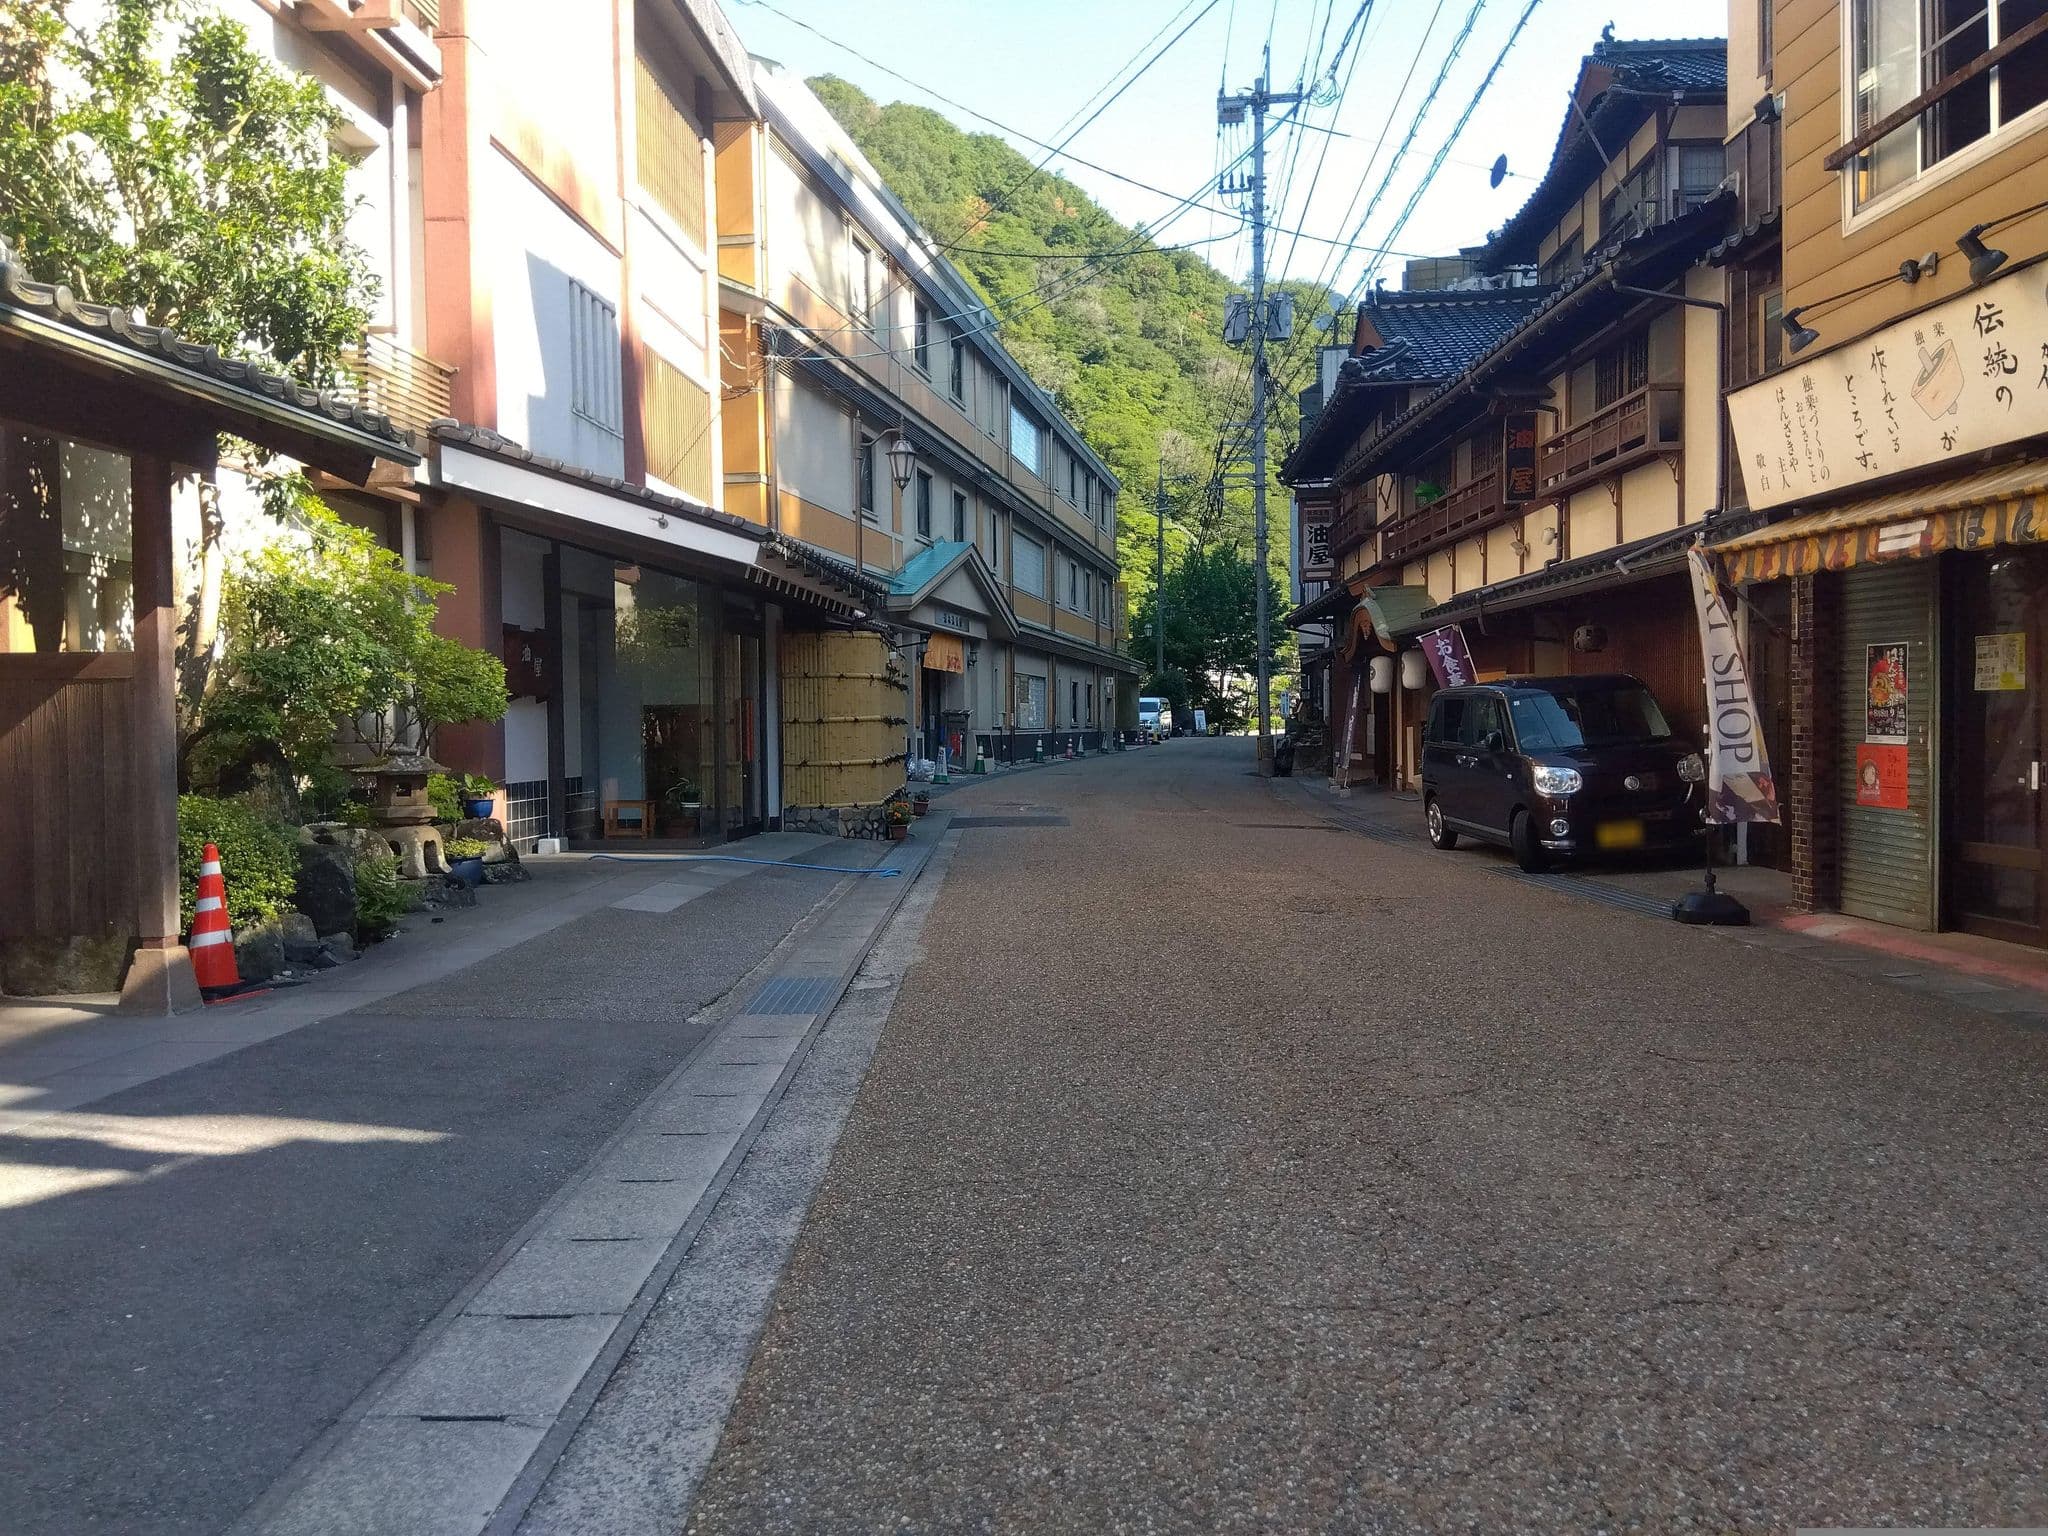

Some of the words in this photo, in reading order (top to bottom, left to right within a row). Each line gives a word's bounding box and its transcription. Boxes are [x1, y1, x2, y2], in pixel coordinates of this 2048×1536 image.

[1913, 321, 1945, 346] 独楽
[1973, 302, 2018, 411] 伝統の
[1775, 386, 1799, 473] はんざきや
[1801, 375, 1831, 481] 独楽づくりの
[1844, 375, 1878, 471] ところです。
[1870, 345, 1901, 453] 作られている
[1941, 426, 1960, 451] が
[1776, 456, 1791, 490] 主人
[1795, 401, 1818, 484] おじさんこと
[1307, 523, 1330, 566] 油屋
[1435, 638, 1466, 687] お食事
[1711, 651, 1753, 763] SHOP
